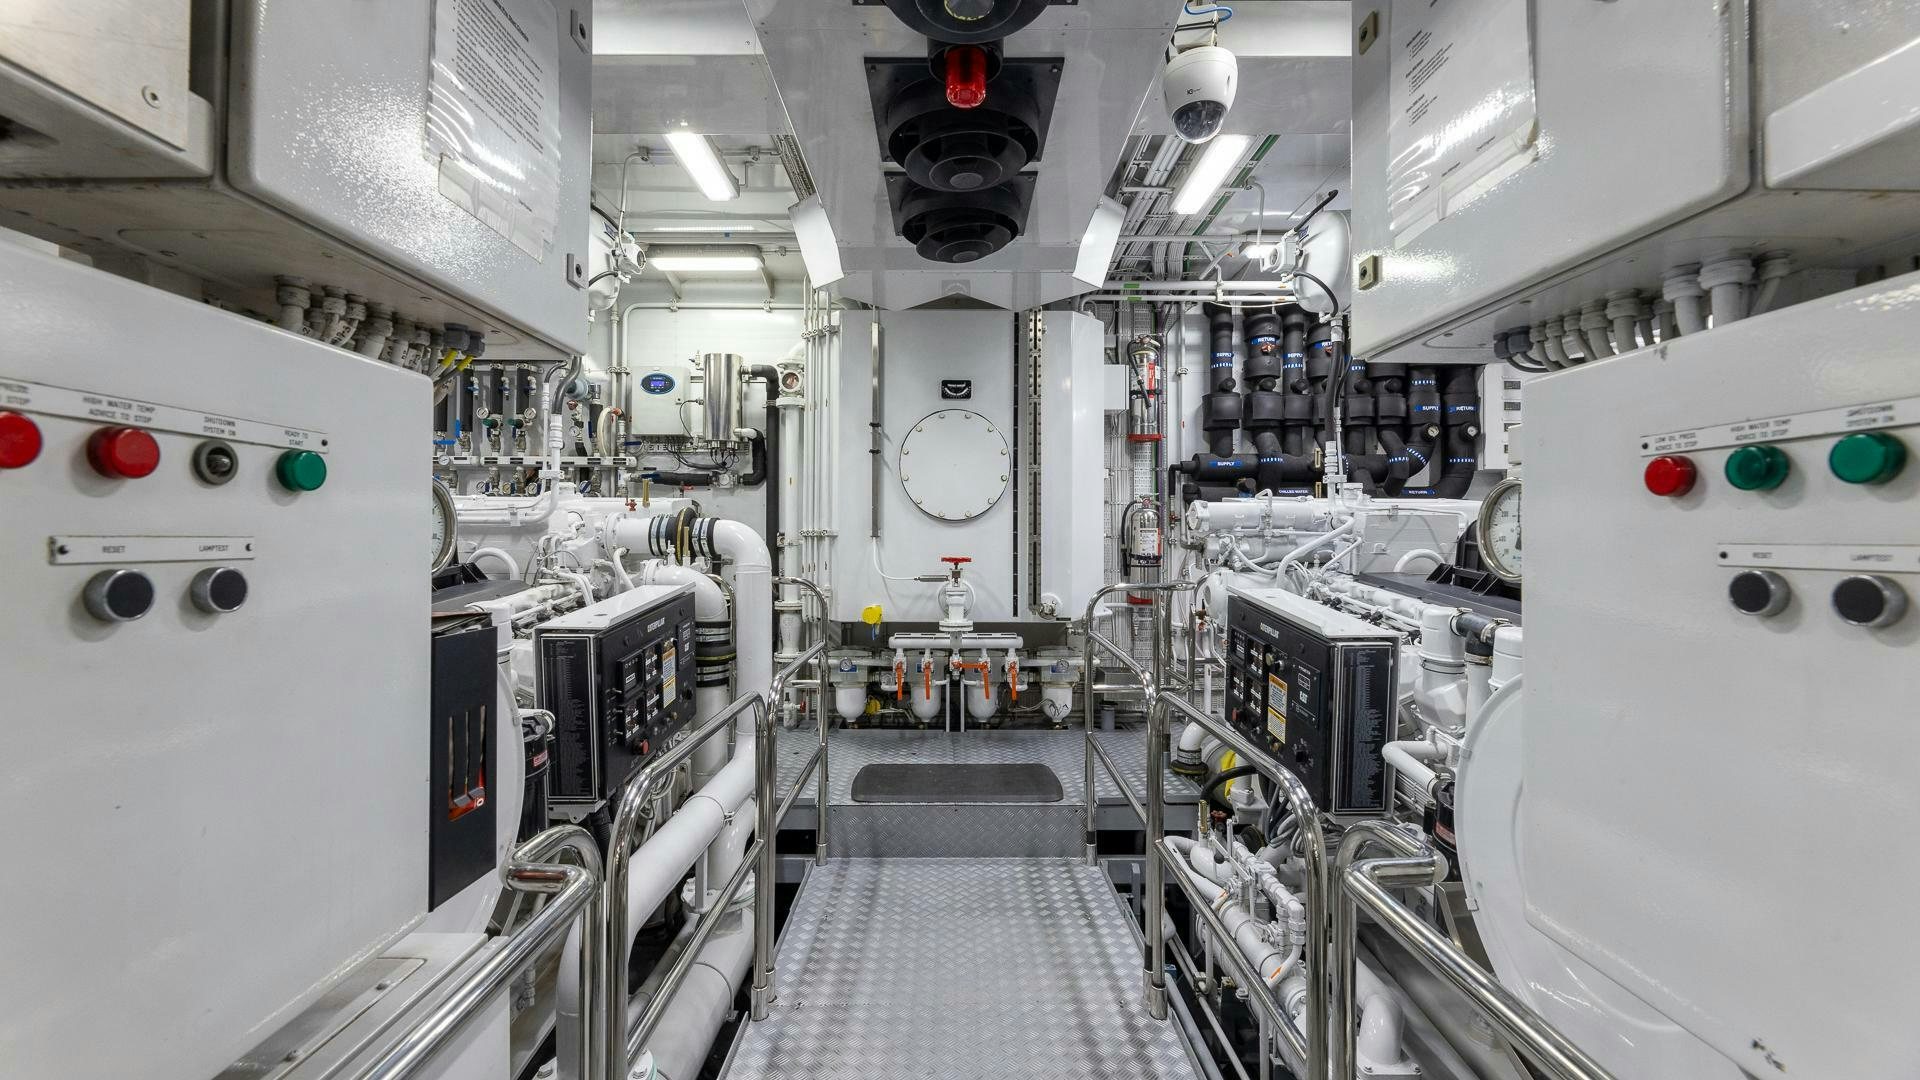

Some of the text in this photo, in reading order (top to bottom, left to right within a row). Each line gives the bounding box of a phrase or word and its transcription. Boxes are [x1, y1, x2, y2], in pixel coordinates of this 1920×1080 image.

[82, 396, 156, 413] HIGH WATER TEMP
[88, 408, 153, 424] ADVICE TO STOP
[203, 416, 236, 427] SHUTDOWN
[203, 425, 225, 435] SYSTEM
[1748, 421, 1771, 431] WATER
[1773, 418, 1792, 427] TEMP
[284, 429, 301, 439] READY
[1654, 436, 1668, 444] LOW
[1679, 432, 1697, 441] PRESS
[1735, 433, 1759, 442] ADVICE
[1771, 428, 1789, 437] STOP
[288, 439, 304, 447] START
[1655, 442, 1675, 451] ADVICE
[1684, 440, 1698, 449] STOP
[102, 544, 229, 554] RESET LAMPTEST
[1752, 551, 1773, 559] RESET
